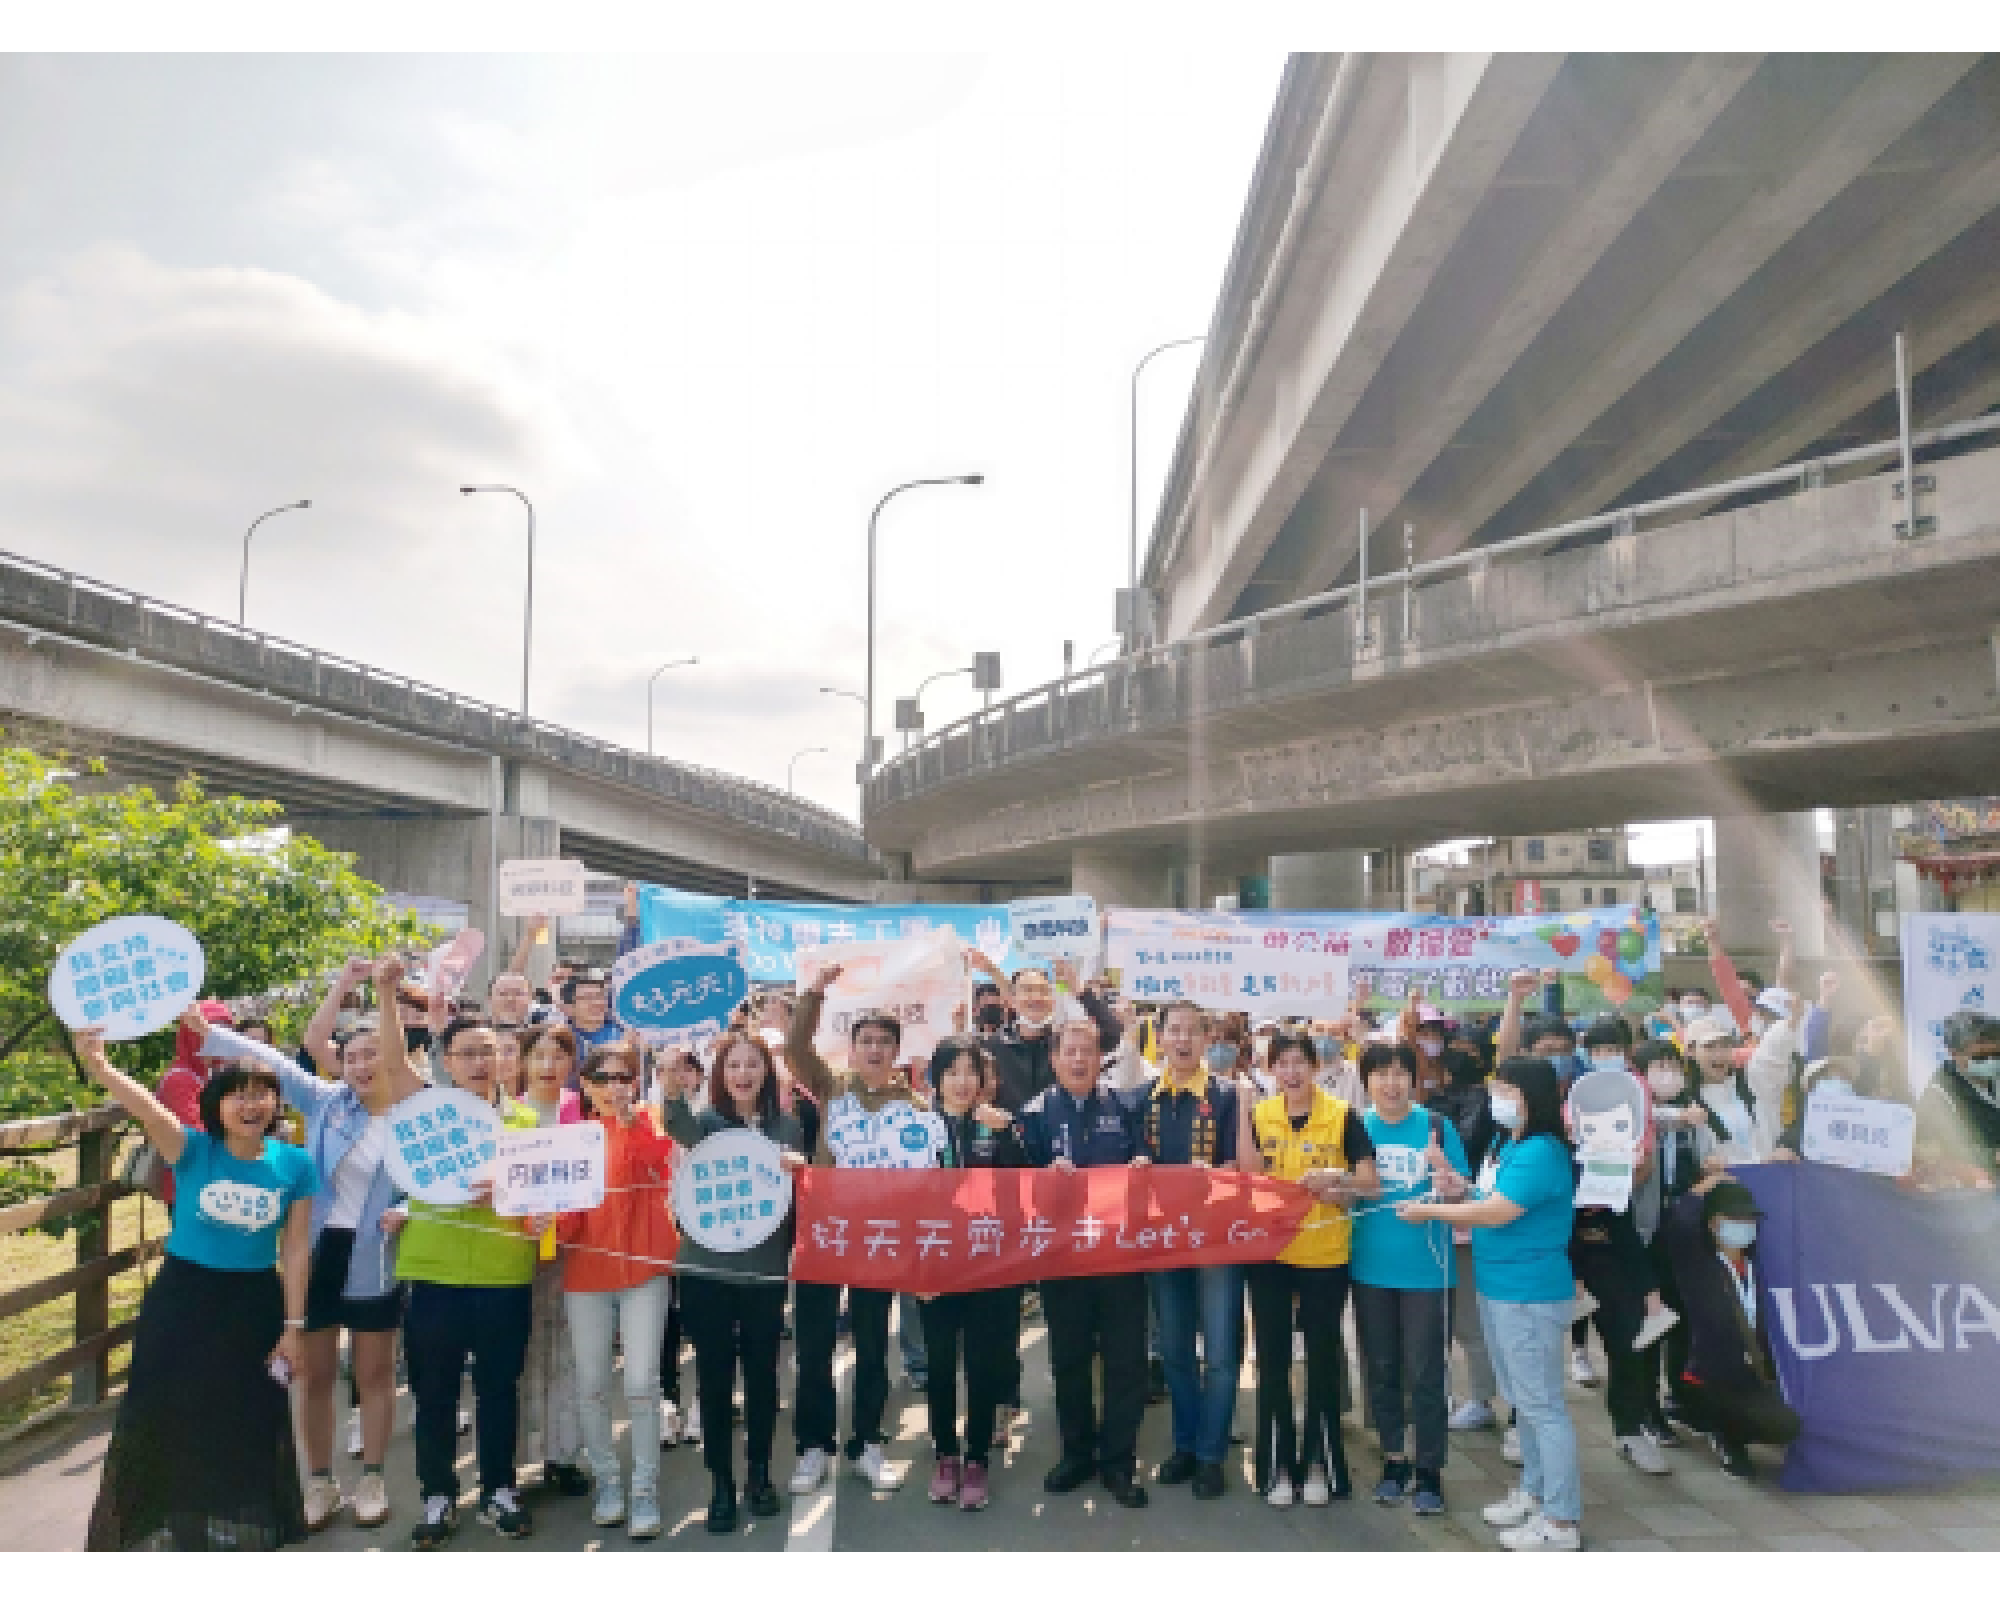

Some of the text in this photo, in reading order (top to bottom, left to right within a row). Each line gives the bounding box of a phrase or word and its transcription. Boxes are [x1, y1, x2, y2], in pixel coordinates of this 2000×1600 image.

[811, 1216, 1107, 1260] 好天天齊步走
[1113, 1215, 1206, 1251] Let's
